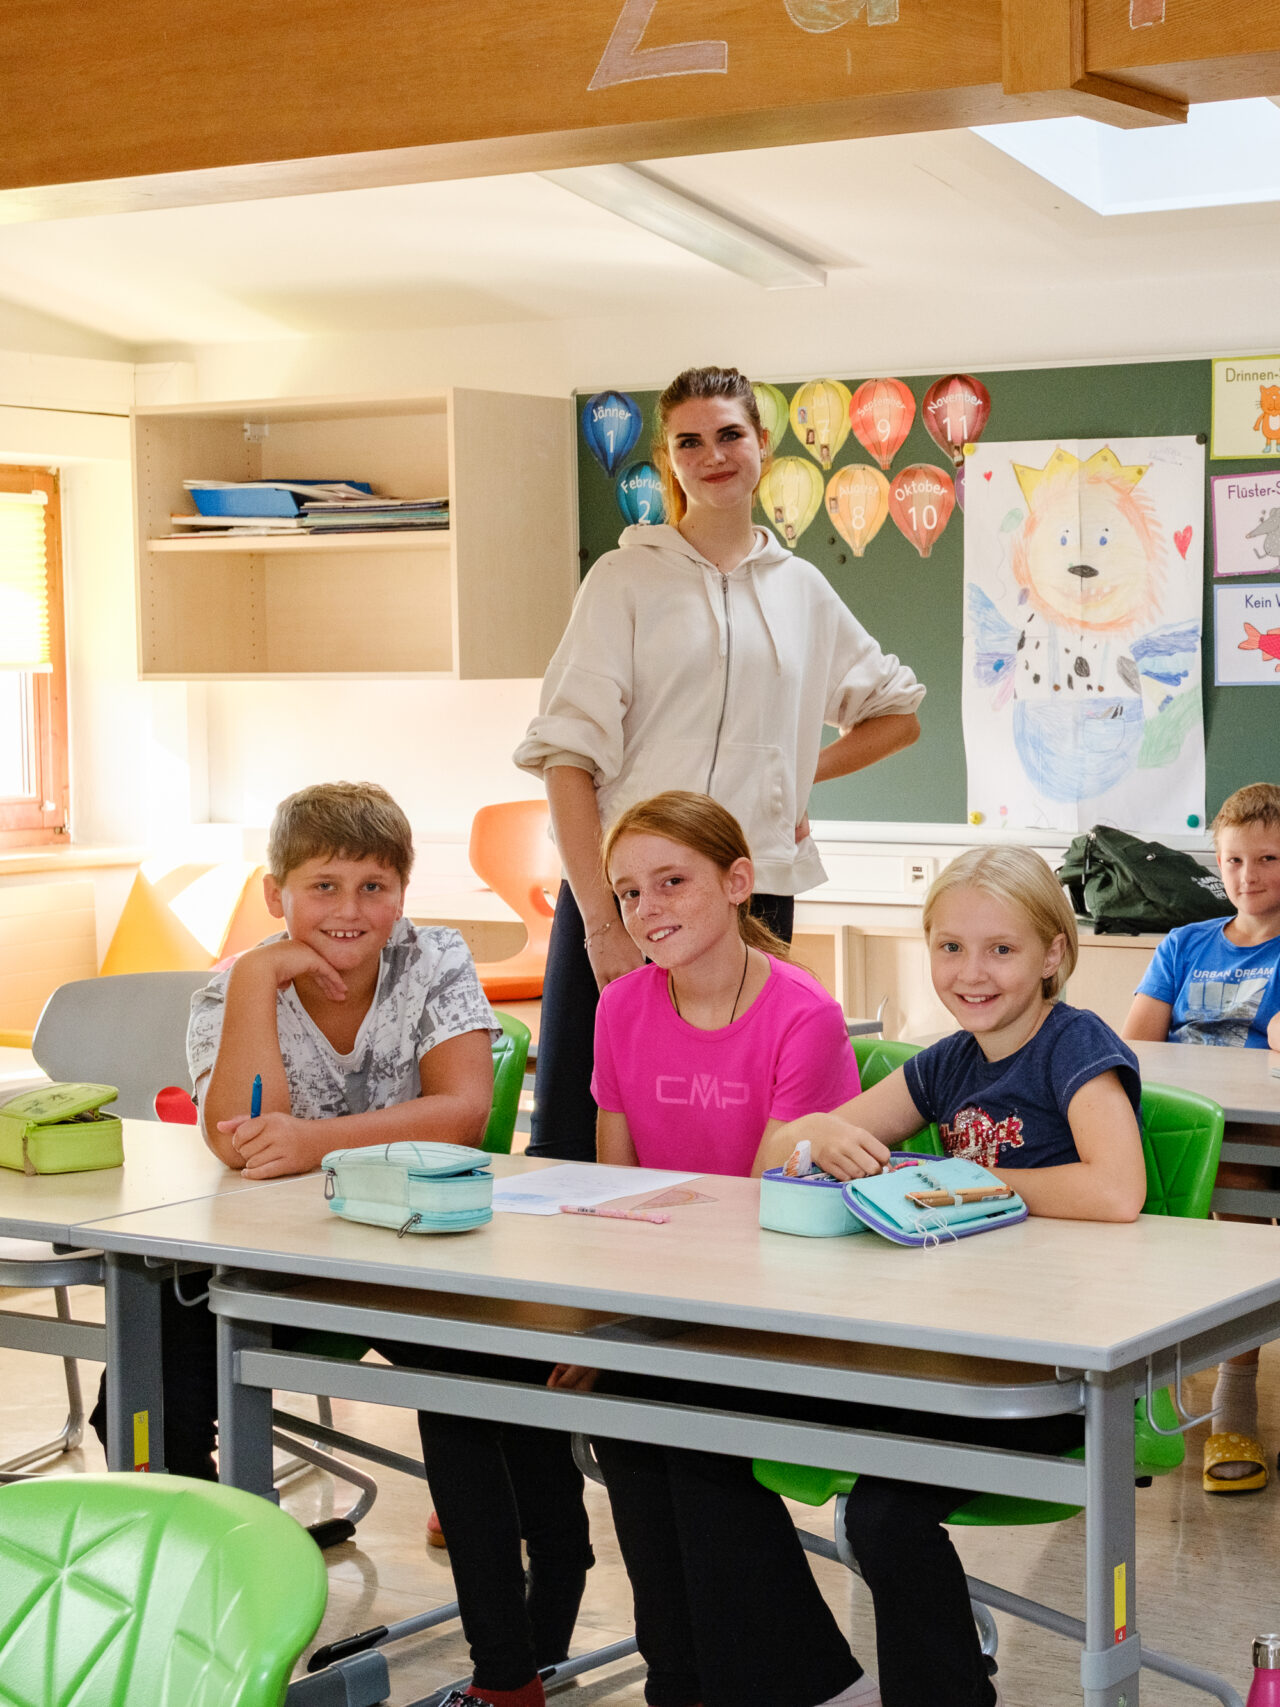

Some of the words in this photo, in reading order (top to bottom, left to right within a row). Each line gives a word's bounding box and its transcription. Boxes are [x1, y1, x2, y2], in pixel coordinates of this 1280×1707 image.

[592, 406, 632, 422] Jänner
[857, 398, 906, 417] September
[927, 391, 983, 415] November
[877, 418, 890, 442] 9
[942, 416, 968, 441] 11
[606, 430, 614, 453] 1
[838, 483, 878, 498] August
[895, 480, 948, 501] Oktober
[638, 500, 651, 524] 2
[851, 506, 866, 530] 8
[907, 505, 937, 531] 10
[1245, 594, 1272, 608] Kein
[1193, 969, 1232, 979] URBAN
[1235, 967, 1274, 978] DREAM
[656, 1073, 750, 1110] CMP
[1117, 1630, 1124, 1641] 4
